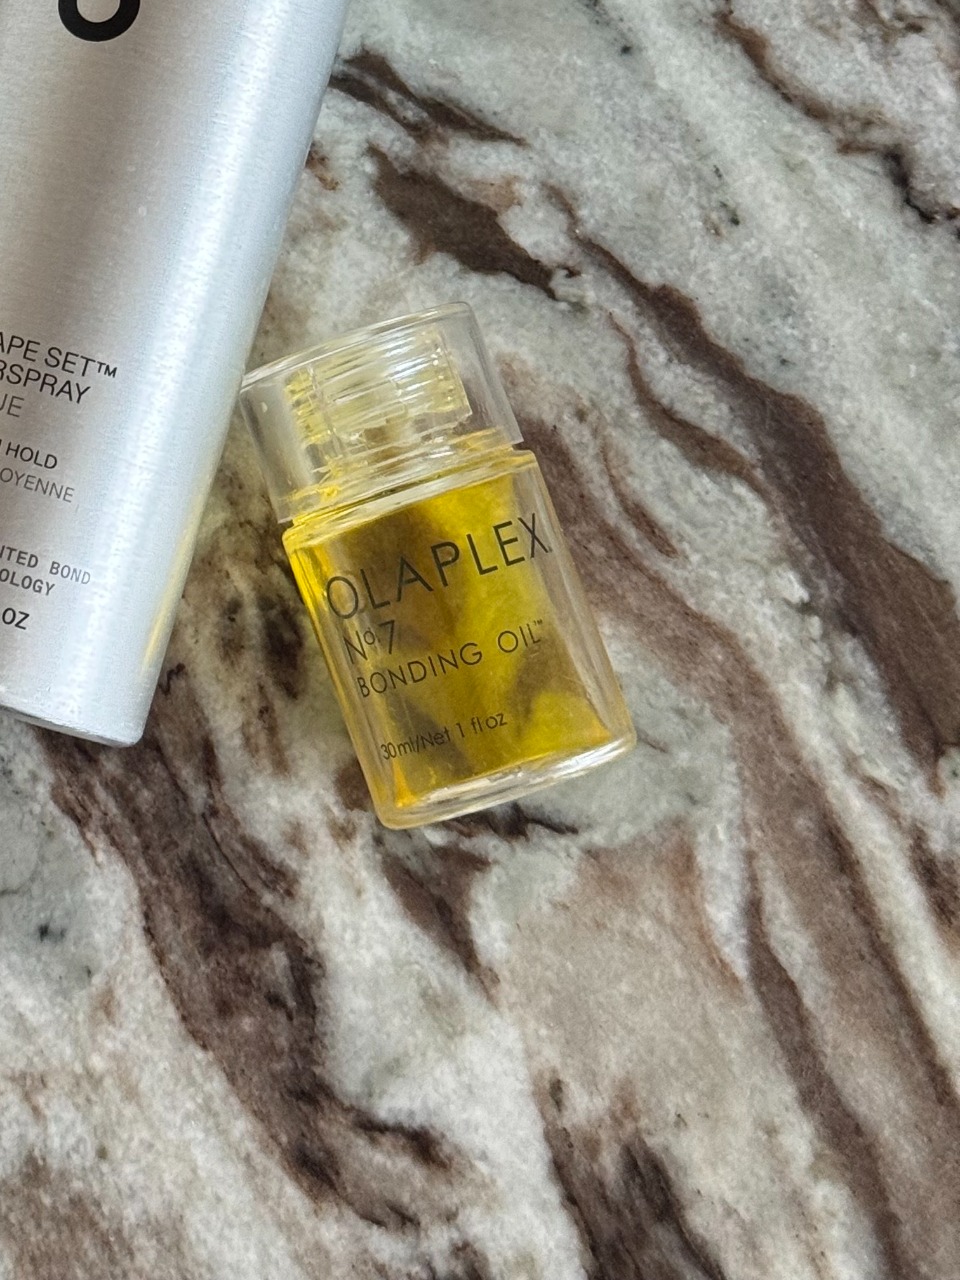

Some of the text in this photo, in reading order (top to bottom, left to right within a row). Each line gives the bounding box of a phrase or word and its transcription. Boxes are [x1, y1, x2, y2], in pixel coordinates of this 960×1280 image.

[5, 442, 58, 470] HOLD
[49, 560, 91, 585] BOND
[326, 513, 550, 619] OLAPLEX
[2, 607, 30, 630] OZ
[357, 642, 482, 697] BONDING
